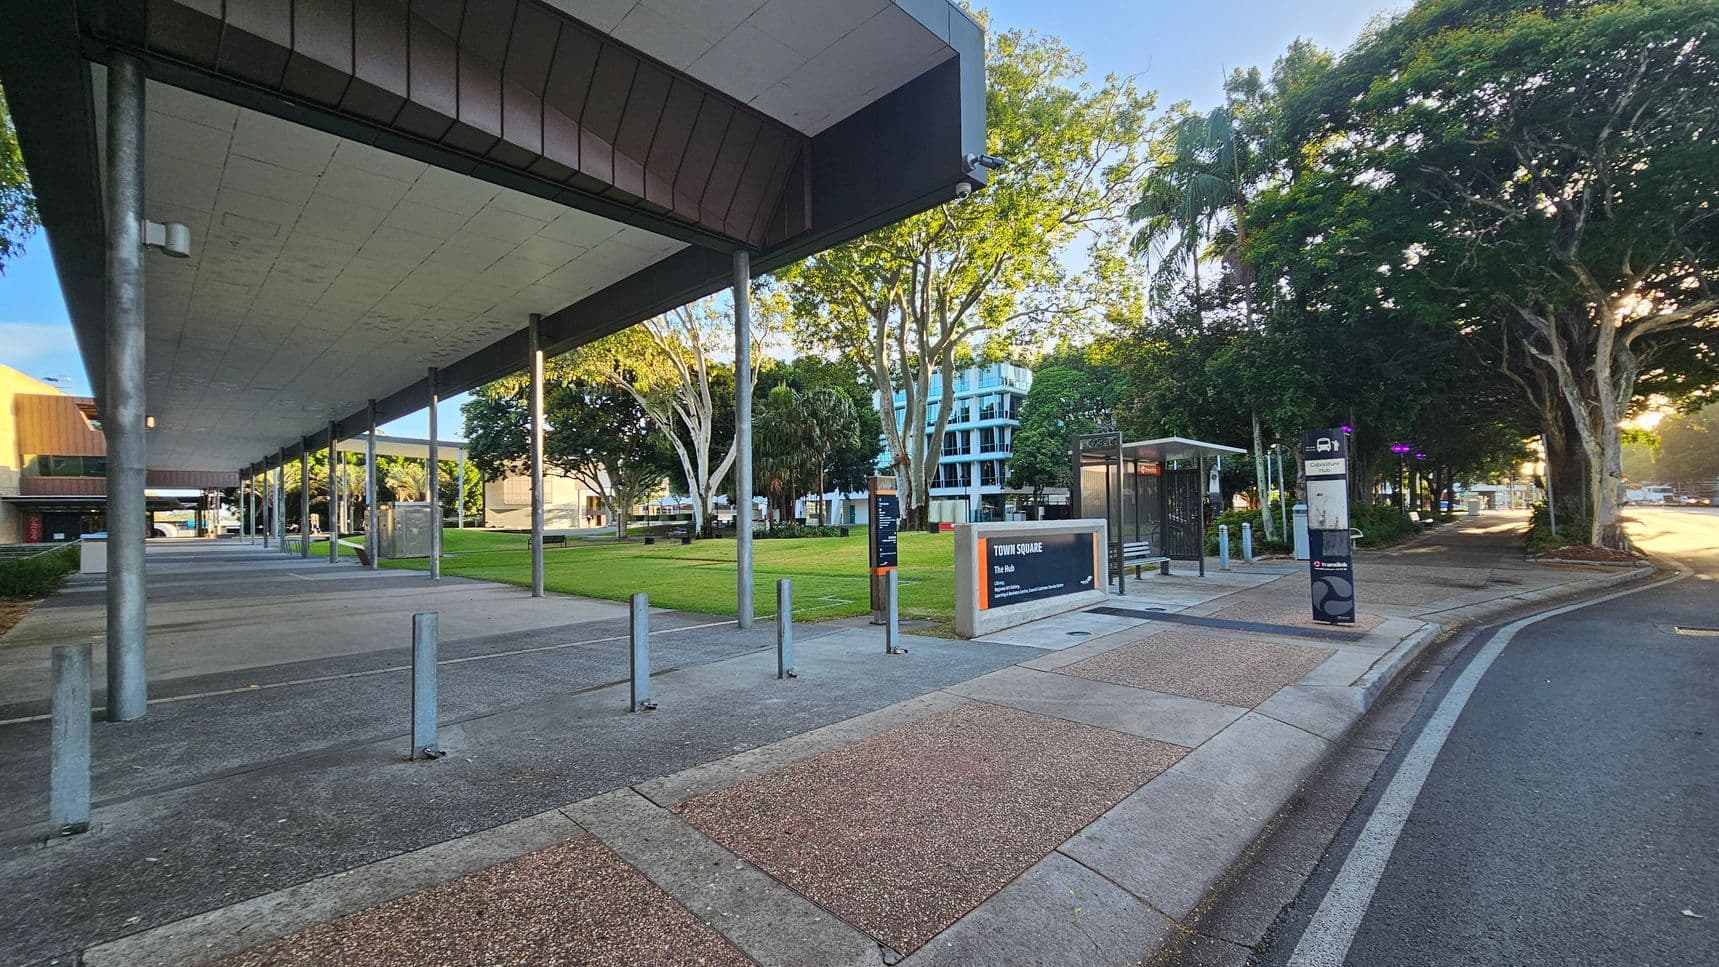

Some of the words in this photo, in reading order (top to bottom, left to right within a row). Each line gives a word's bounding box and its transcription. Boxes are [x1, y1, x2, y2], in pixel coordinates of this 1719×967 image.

[993, 544, 1016, 557] TOWN
[1016, 542, 1043, 556] SQUARE
[994, 565, 1004, 574] The
[1004, 564, 1015, 573] Hub
